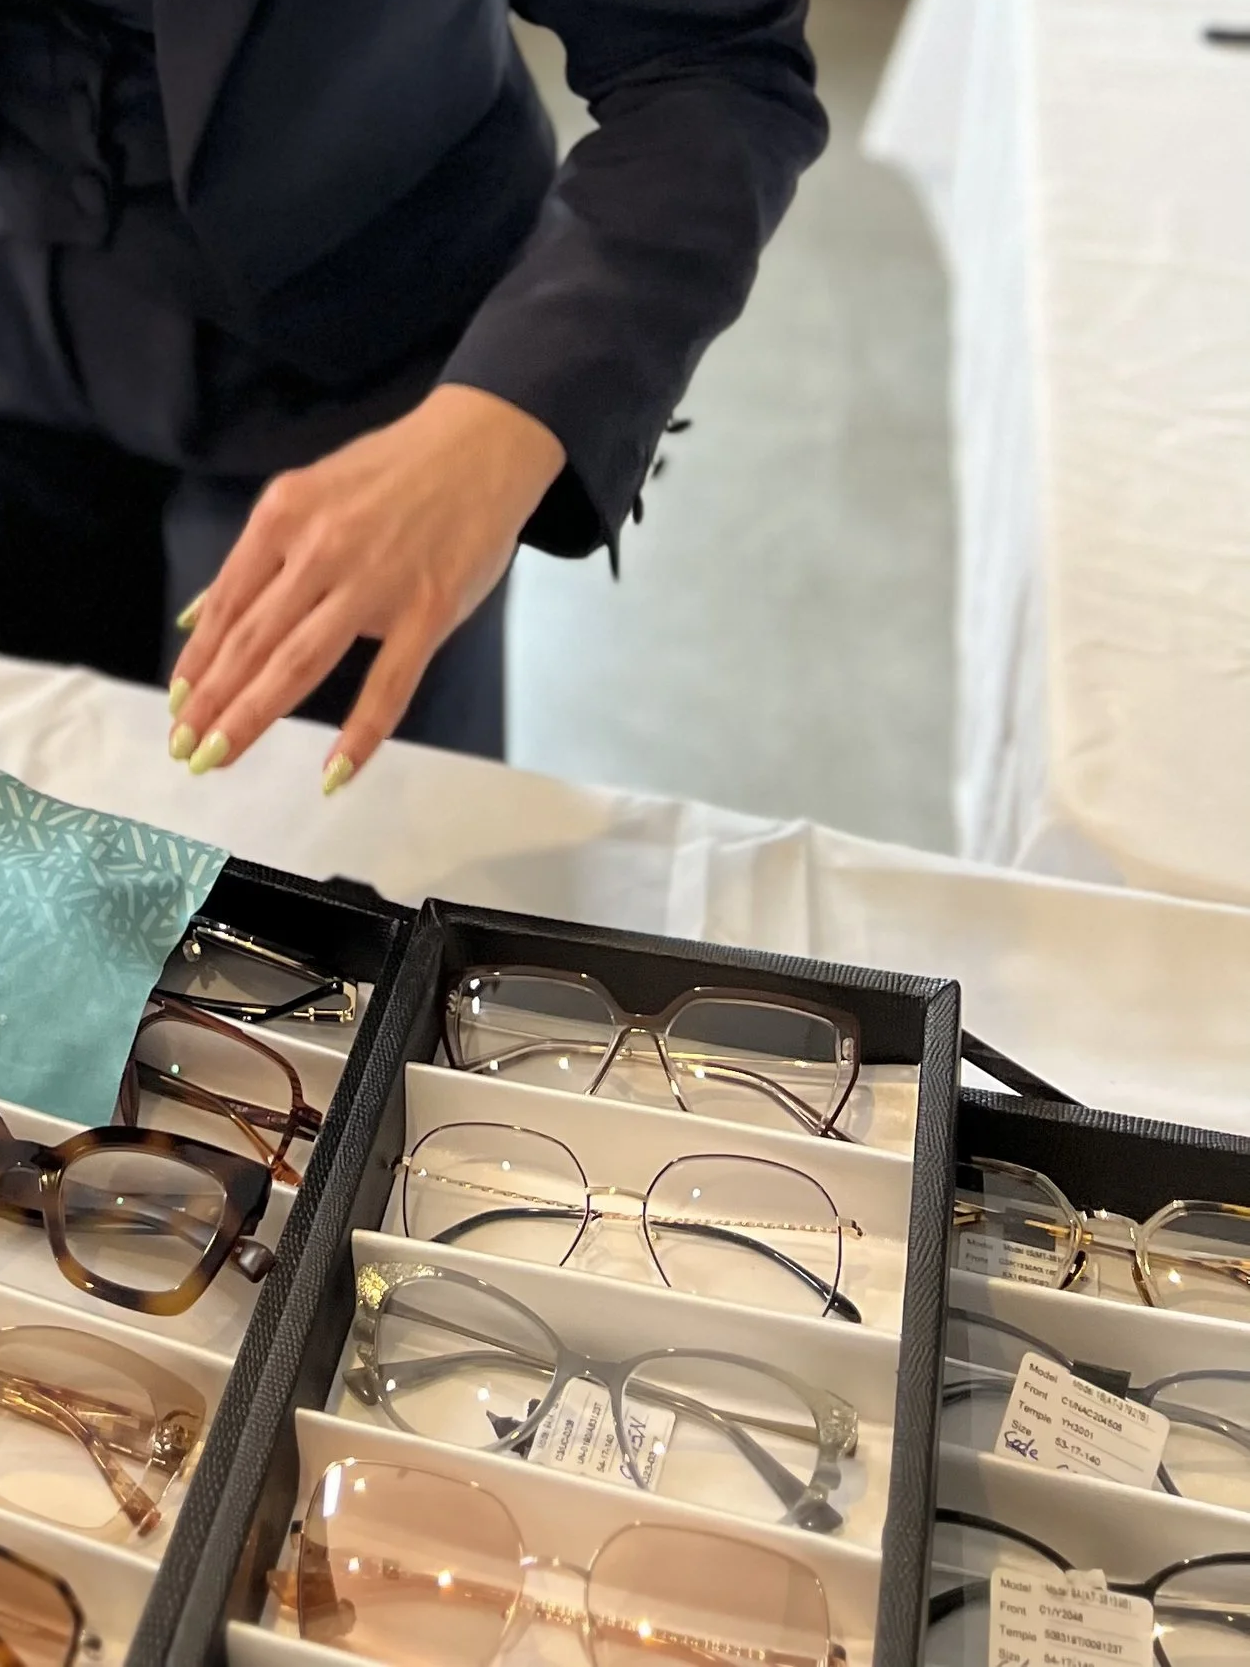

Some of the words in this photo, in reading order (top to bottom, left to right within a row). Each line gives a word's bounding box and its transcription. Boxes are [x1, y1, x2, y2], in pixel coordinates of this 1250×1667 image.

[1029, 1362, 1058, 1384] Model
[1023, 1381, 1049, 1401] Front
[1018, 1399, 1052, 1425] Temple
[1011, 1419, 1032, 1436] Size
[1000, 1578, 1032, 1593] Model
[1000, 1600, 1027, 1616] Front
